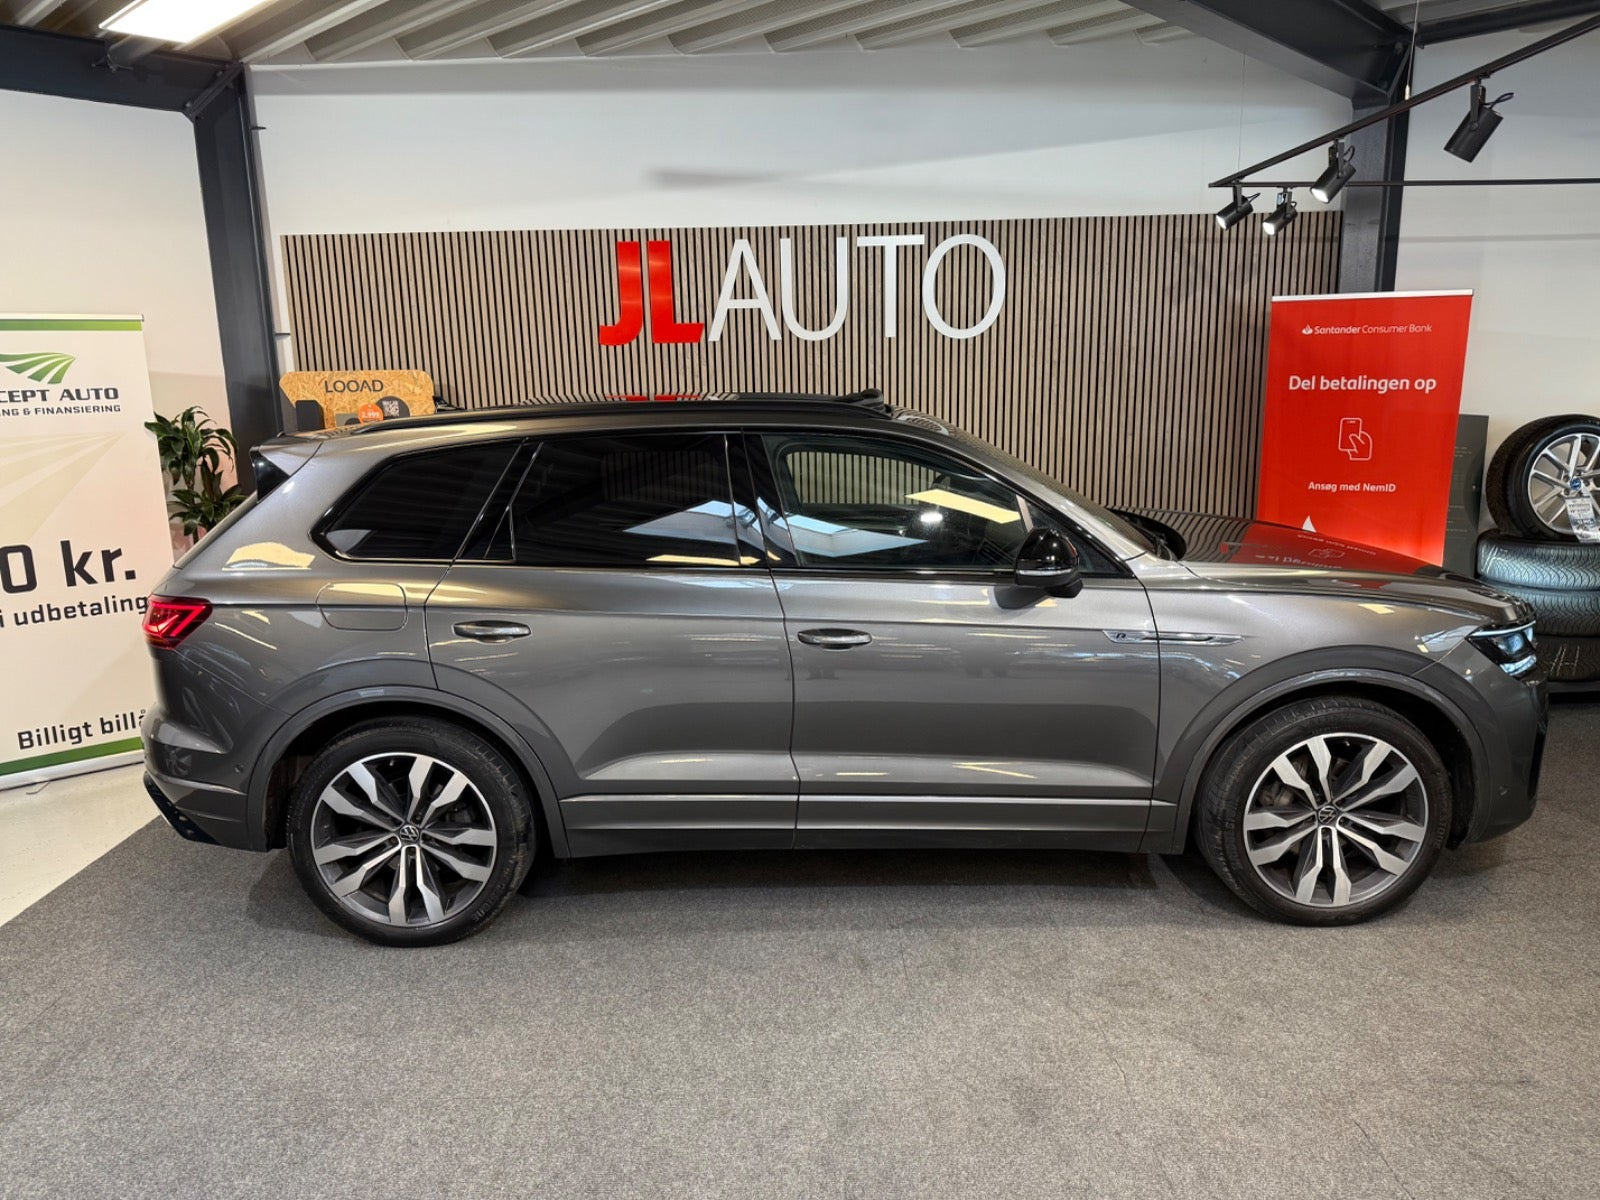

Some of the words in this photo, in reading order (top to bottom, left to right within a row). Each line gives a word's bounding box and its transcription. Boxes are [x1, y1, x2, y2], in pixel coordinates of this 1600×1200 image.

[598, 240, 705, 346] JL
[708, 234, 1006, 342] AUTO
[1314, 325, 1360, 335] Santander
[1408, 324, 1432, 333] Bank
[325, 379, 384, 393] LOOAD
[1289, 375, 1316, 391] Del
[1320, 375, 1410, 394] betalingen
[1414, 378, 1437, 394] op
[59, 387, 119, 401] AUTO
[23, 407, 31, 416] &
[35, 404, 121, 415] FINANSIERING
[1308, 481, 1338, 493] Ansøg
[1340, 482, 1361, 492] med
[1362, 483, 1397, 493] NemID
[0, 544, 38, 594] 0
[60, 540, 137, 587] kr.
[14, 595, 148, 626] udbetaling
[17, 721, 94, 750] Billigt
